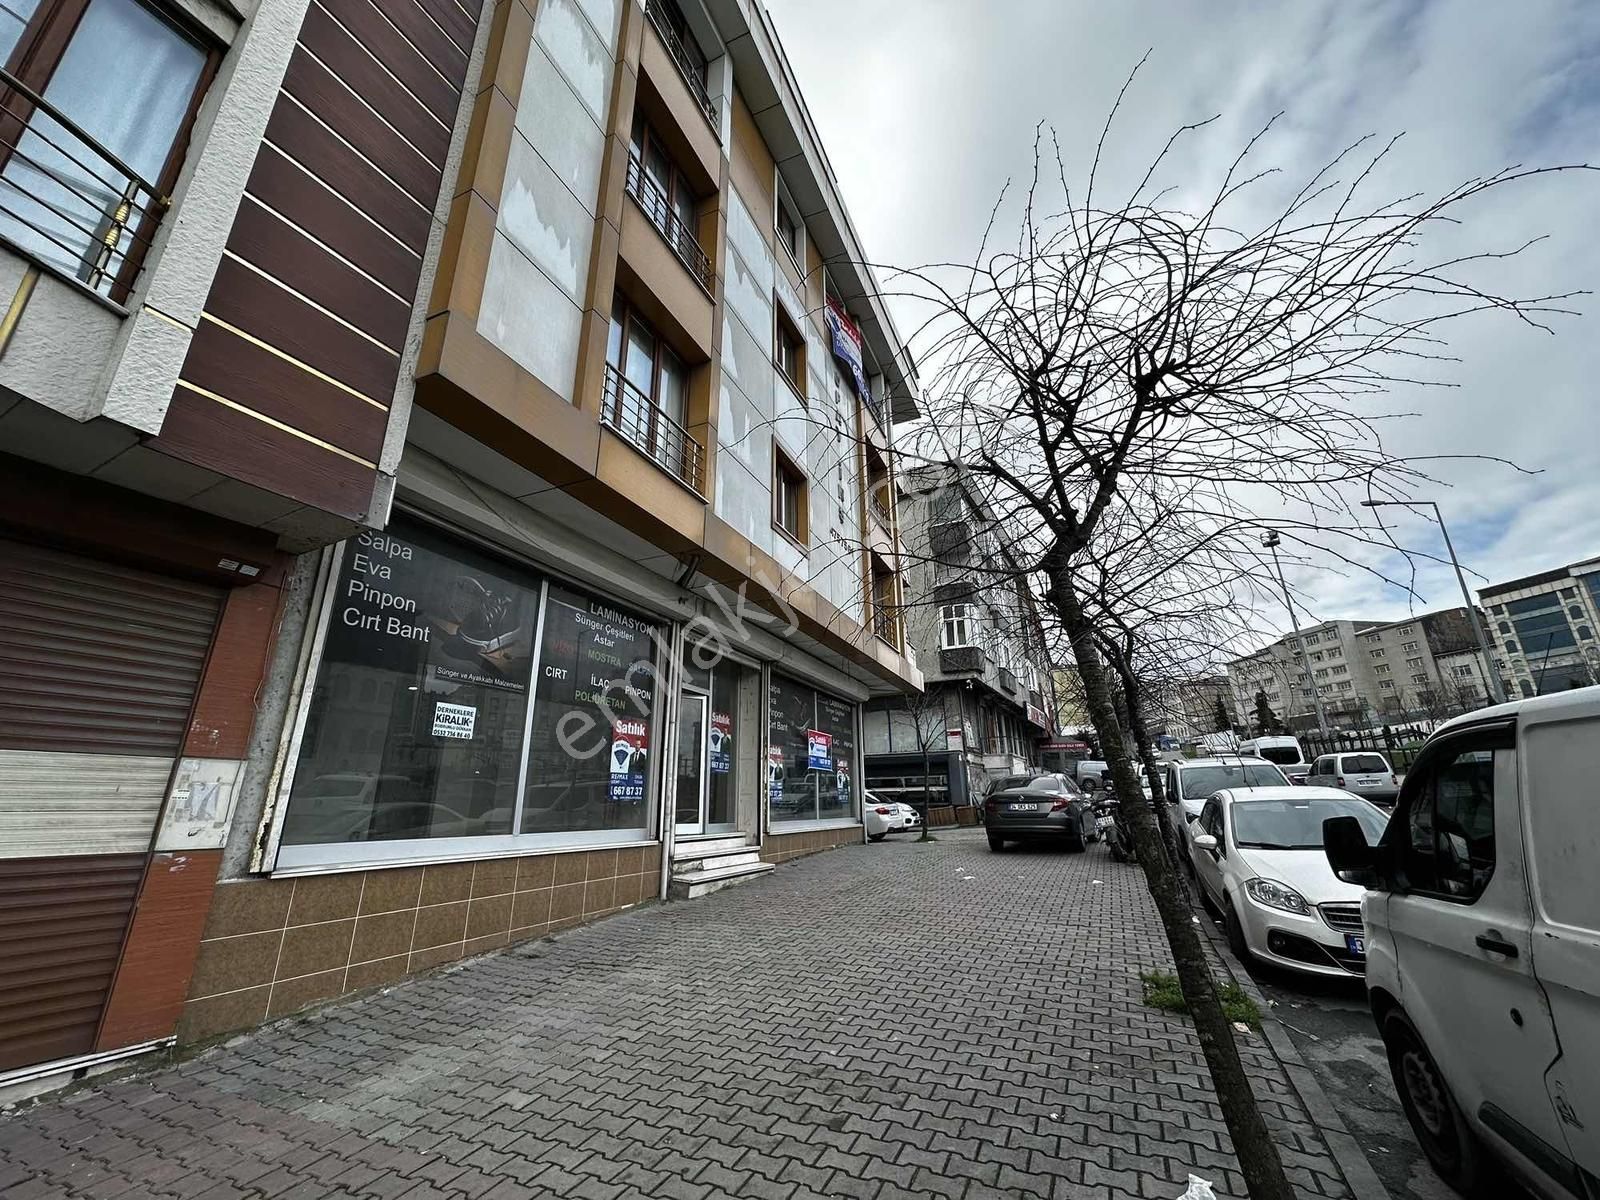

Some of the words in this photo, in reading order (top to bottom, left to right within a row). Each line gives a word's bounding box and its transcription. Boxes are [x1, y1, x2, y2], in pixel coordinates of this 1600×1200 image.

[358, 530, 412, 560] Salpa
[353, 553, 391, 580] Eva
[348, 579, 416, 613] Pinpon
[343, 607, 381, 632] Cırt
[386, 616, 430, 643] Bant
[575, 612, 603, 631] Sünger
[593, 633, 615, 648] Astar
[587, 649, 621, 669] MOSTRA
[545, 666, 568, 680] CIRT
[590, 673, 610, 690] İLAÇ
[625, 685, 652, 700] PİNPON
[437, 706, 474, 718] DERNEKLERE
[616, 720, 645, 737] Satılık
[626, 786, 634, 796] 87
[635, 787, 643, 796] 37
